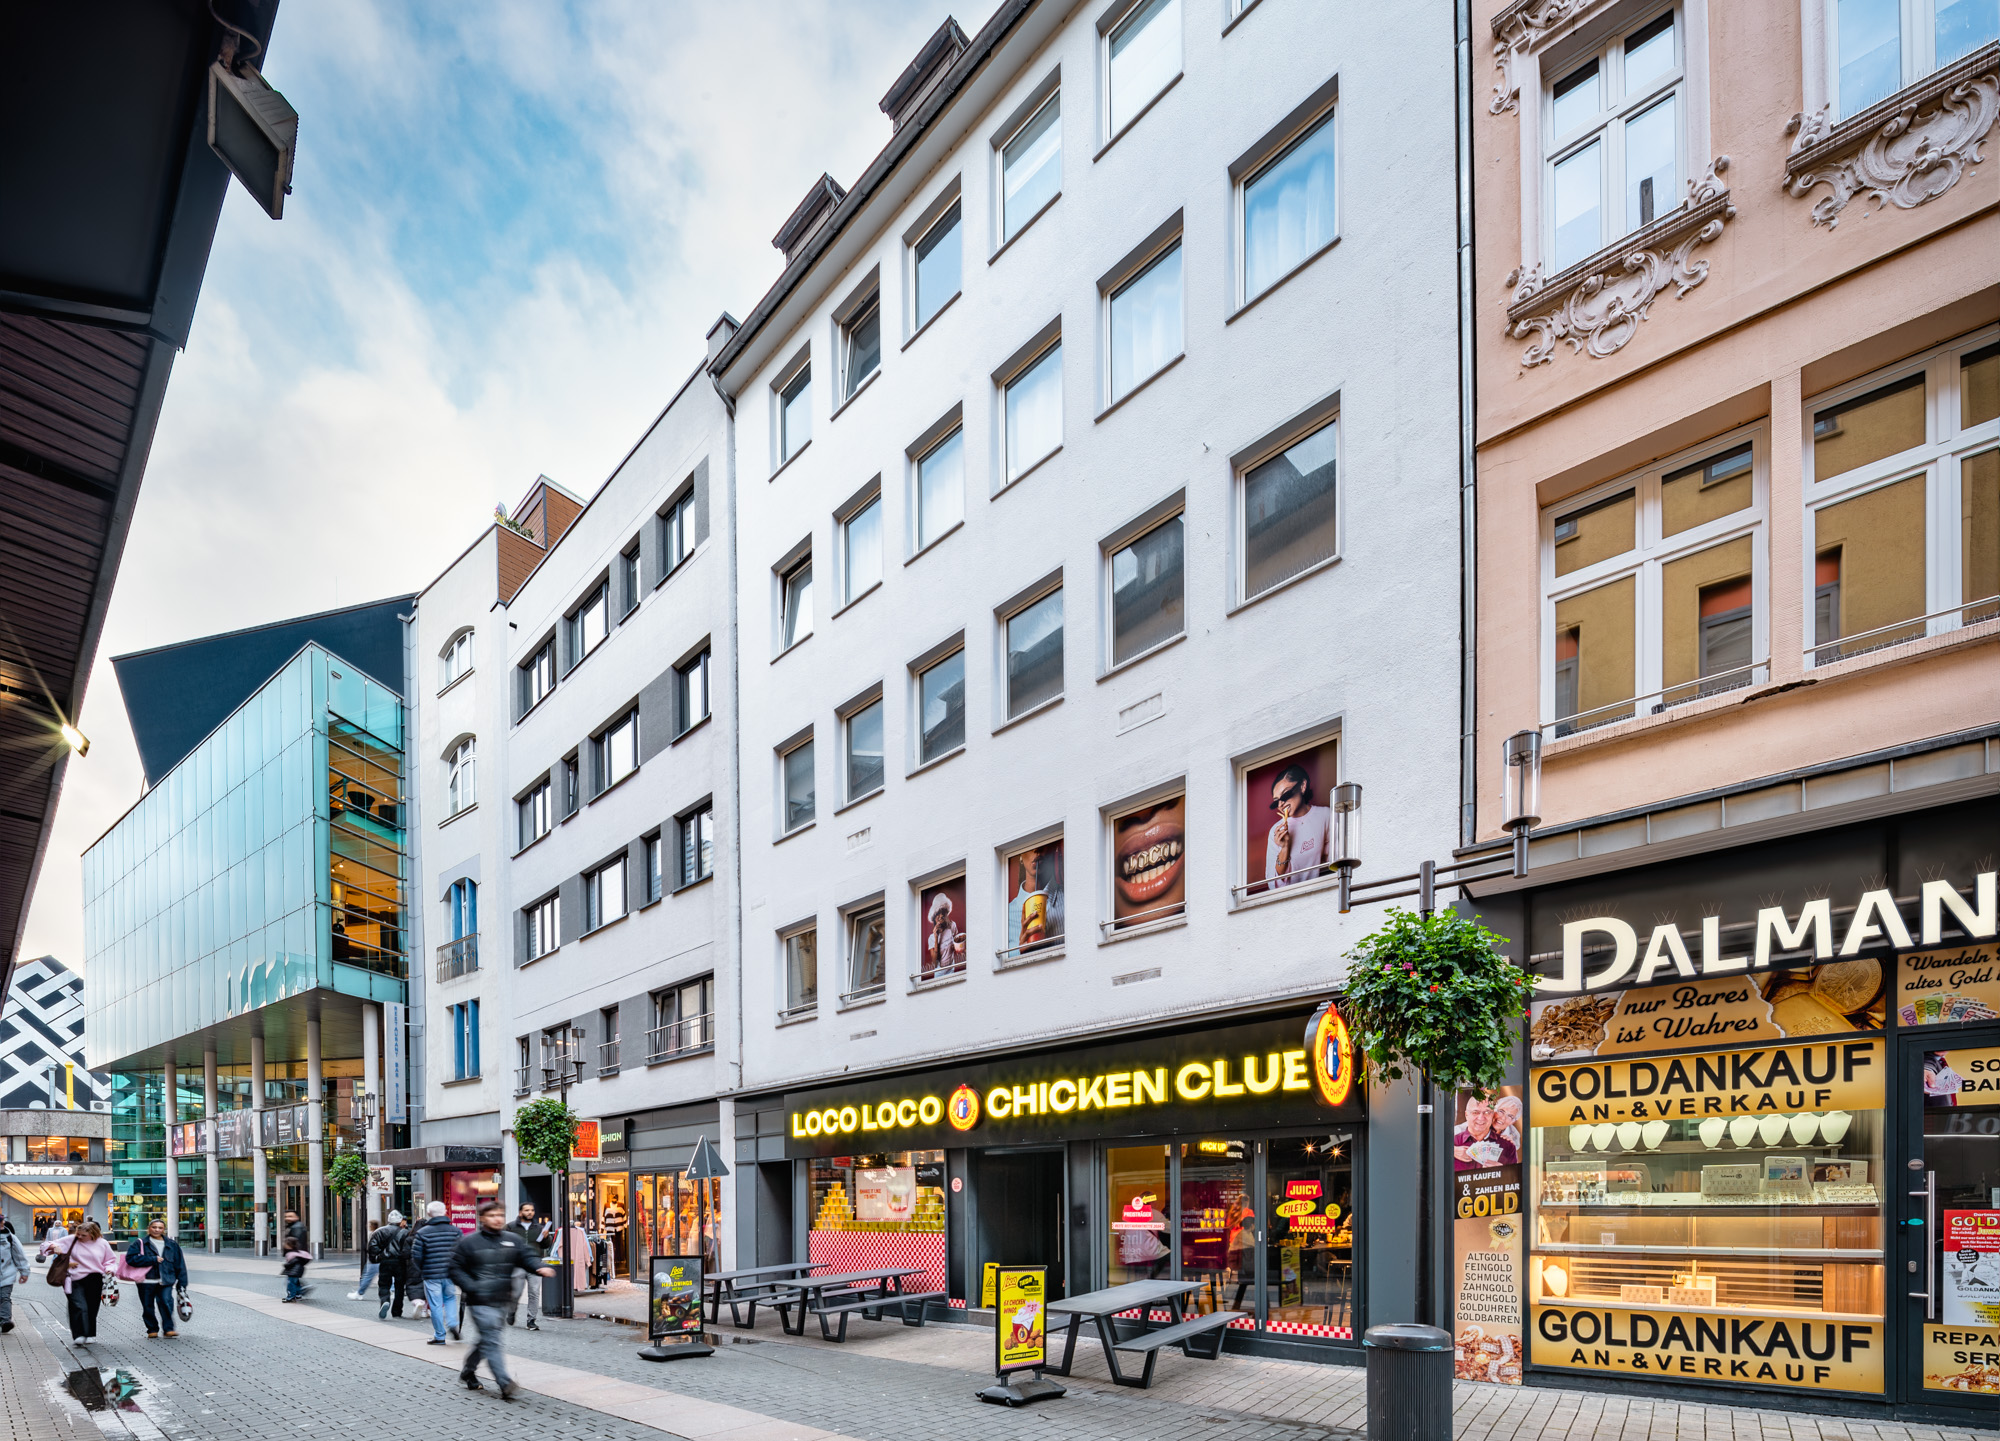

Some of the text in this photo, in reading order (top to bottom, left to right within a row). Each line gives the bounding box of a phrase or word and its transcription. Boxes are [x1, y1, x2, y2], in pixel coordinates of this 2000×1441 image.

[1906, 948, 1991, 971] Wandeln
[1905, 967, 1993, 991] altes Gold
[1623, 986, 1749, 1016] nur Bares
[1616, 1012, 1759, 1044] ist Wahres
[1537, 1042, 1874, 1103] GOLDANKAUF
[987, 1067, 1169, 1118] CHICKEN
[793, 1095, 944, 1138] LOCO LOCO
[1201, 1141, 1217, 1152] PICK
[1217, 1142, 1227, 1153] UP
[4, 1163, 73, 1176] Schwarze
[1458, 1171, 1501, 1183] WIR KAUFEN
[1289, 1185, 1318, 1195] JUICY
[1462, 1183, 1520, 1196] & ZAHLEN BAR
[1283, 1202, 1309, 1214] FILETS
[1457, 1191, 1519, 1219] GOLD
[1297, 1216, 1327, 1226] WINGS
[1951, 1216, 1998, 1226] GOLD
[1467, 1253, 1510, 1262] ALTGOLD
[1464, 1263, 1513, 1272] FEINGOLD
[1465, 1272, 1512, 1282] SCHMUCK
[1463, 1282, 1514, 1293] ZAHNGOLD
[1460, 1292, 1518, 1303] BRUCHGOLD
[1459, 1302, 1518, 1314] GOLDUHREN
[1456, 1312, 1520, 1324] GOLDBARREN
[1538, 1309, 1873, 1363] GOLDANKAUF
